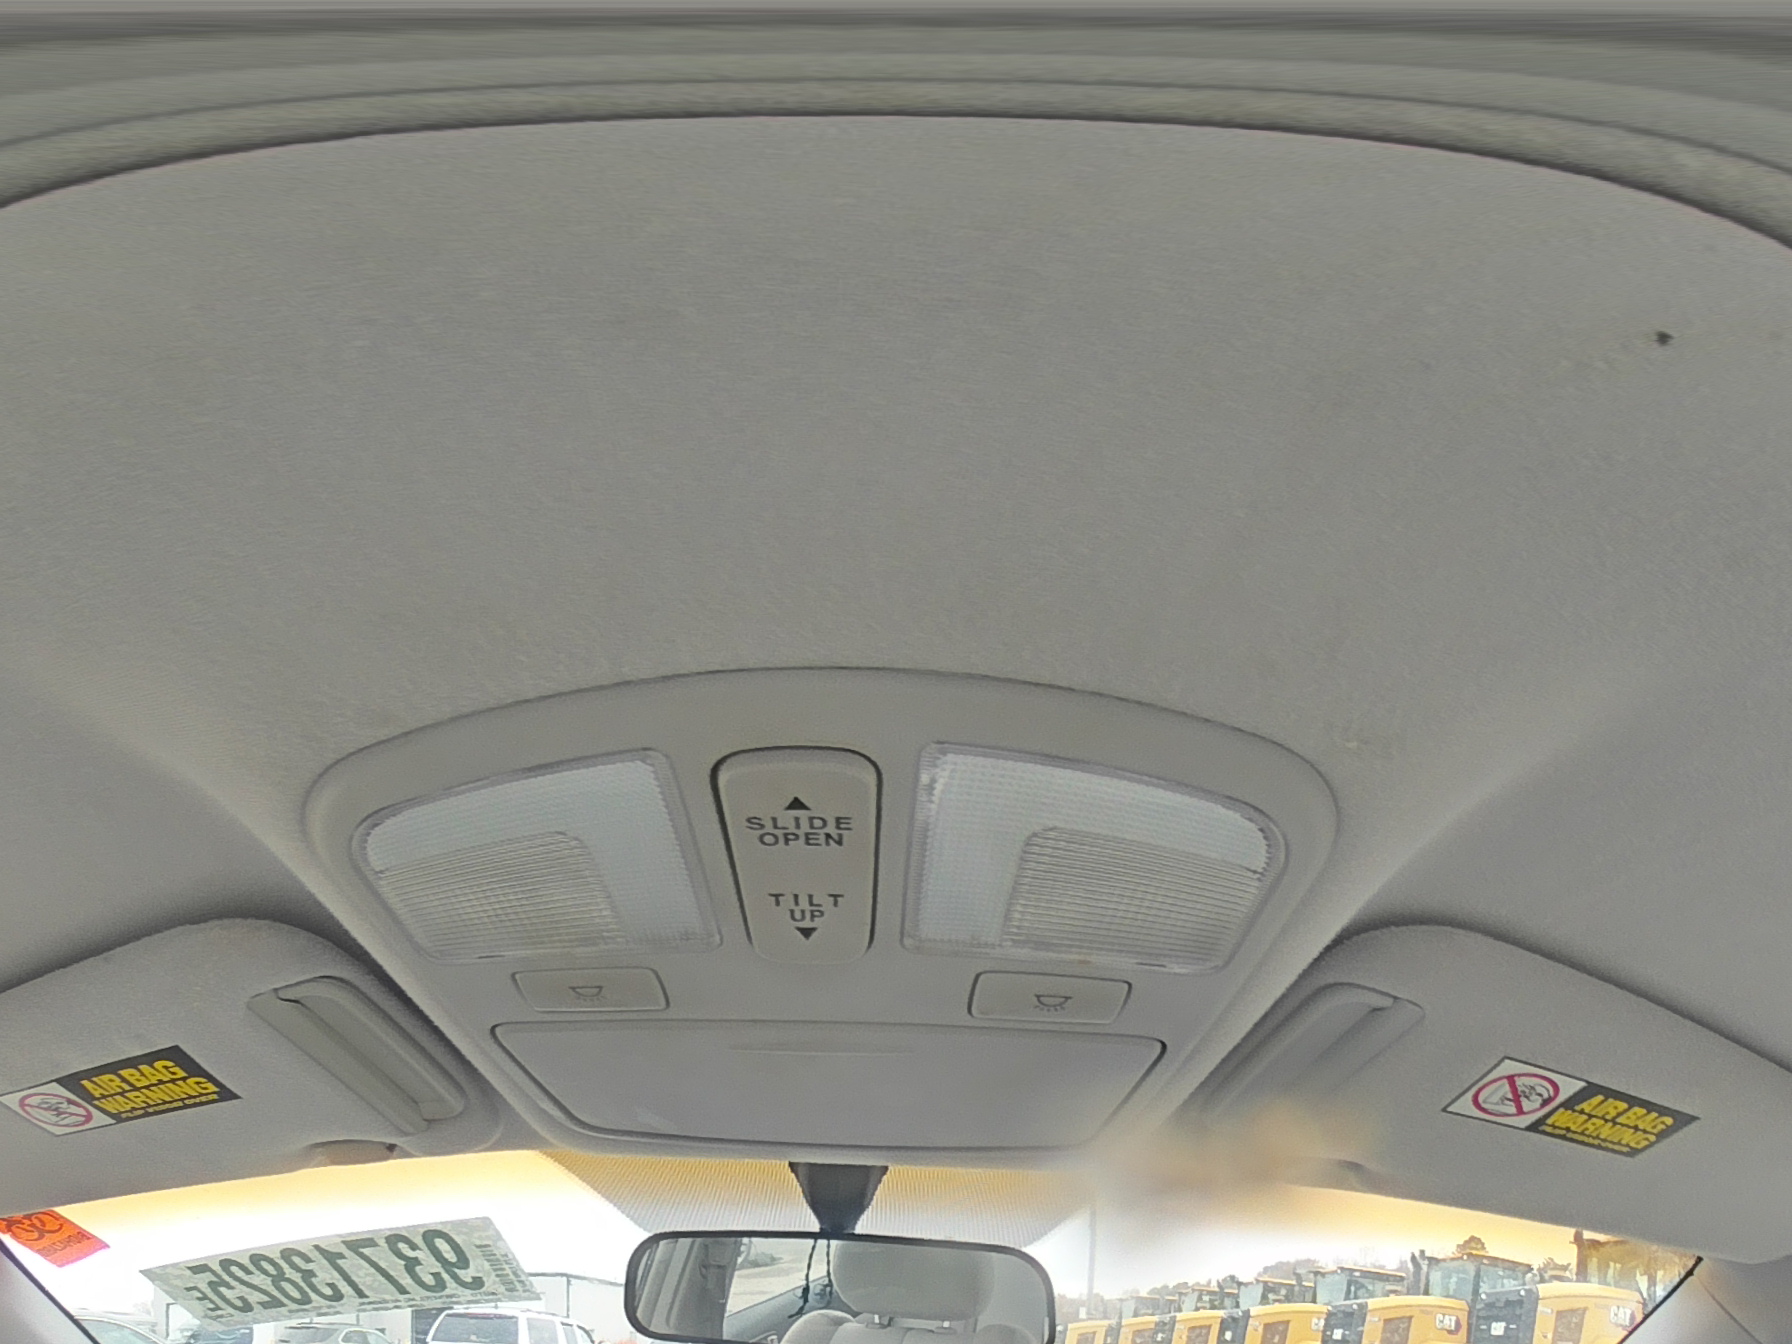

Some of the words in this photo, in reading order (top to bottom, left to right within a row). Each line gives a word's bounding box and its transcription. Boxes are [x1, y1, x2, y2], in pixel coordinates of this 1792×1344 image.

[745, 816, 853, 831] SLIDE
[758, 832, 844, 847] OPEN
[768, 893, 845, 908] TILT
[788, 909, 825, 923] UP
[80, 1074, 131, 1098] AIR
[117, 1060, 188, 1088] BAG
[92, 1077, 220, 1114] WARNING
[1574, 1094, 1629, 1121] AIR
[1616, 1106, 1675, 1134] BAG
[1544, 1107, 1657, 1150] WARNING
[1311, 1317, 1325, 1332] CA
[1435, 1313, 1457, 1331] CAT
[1610, 1305, 1632, 1327] CAT
